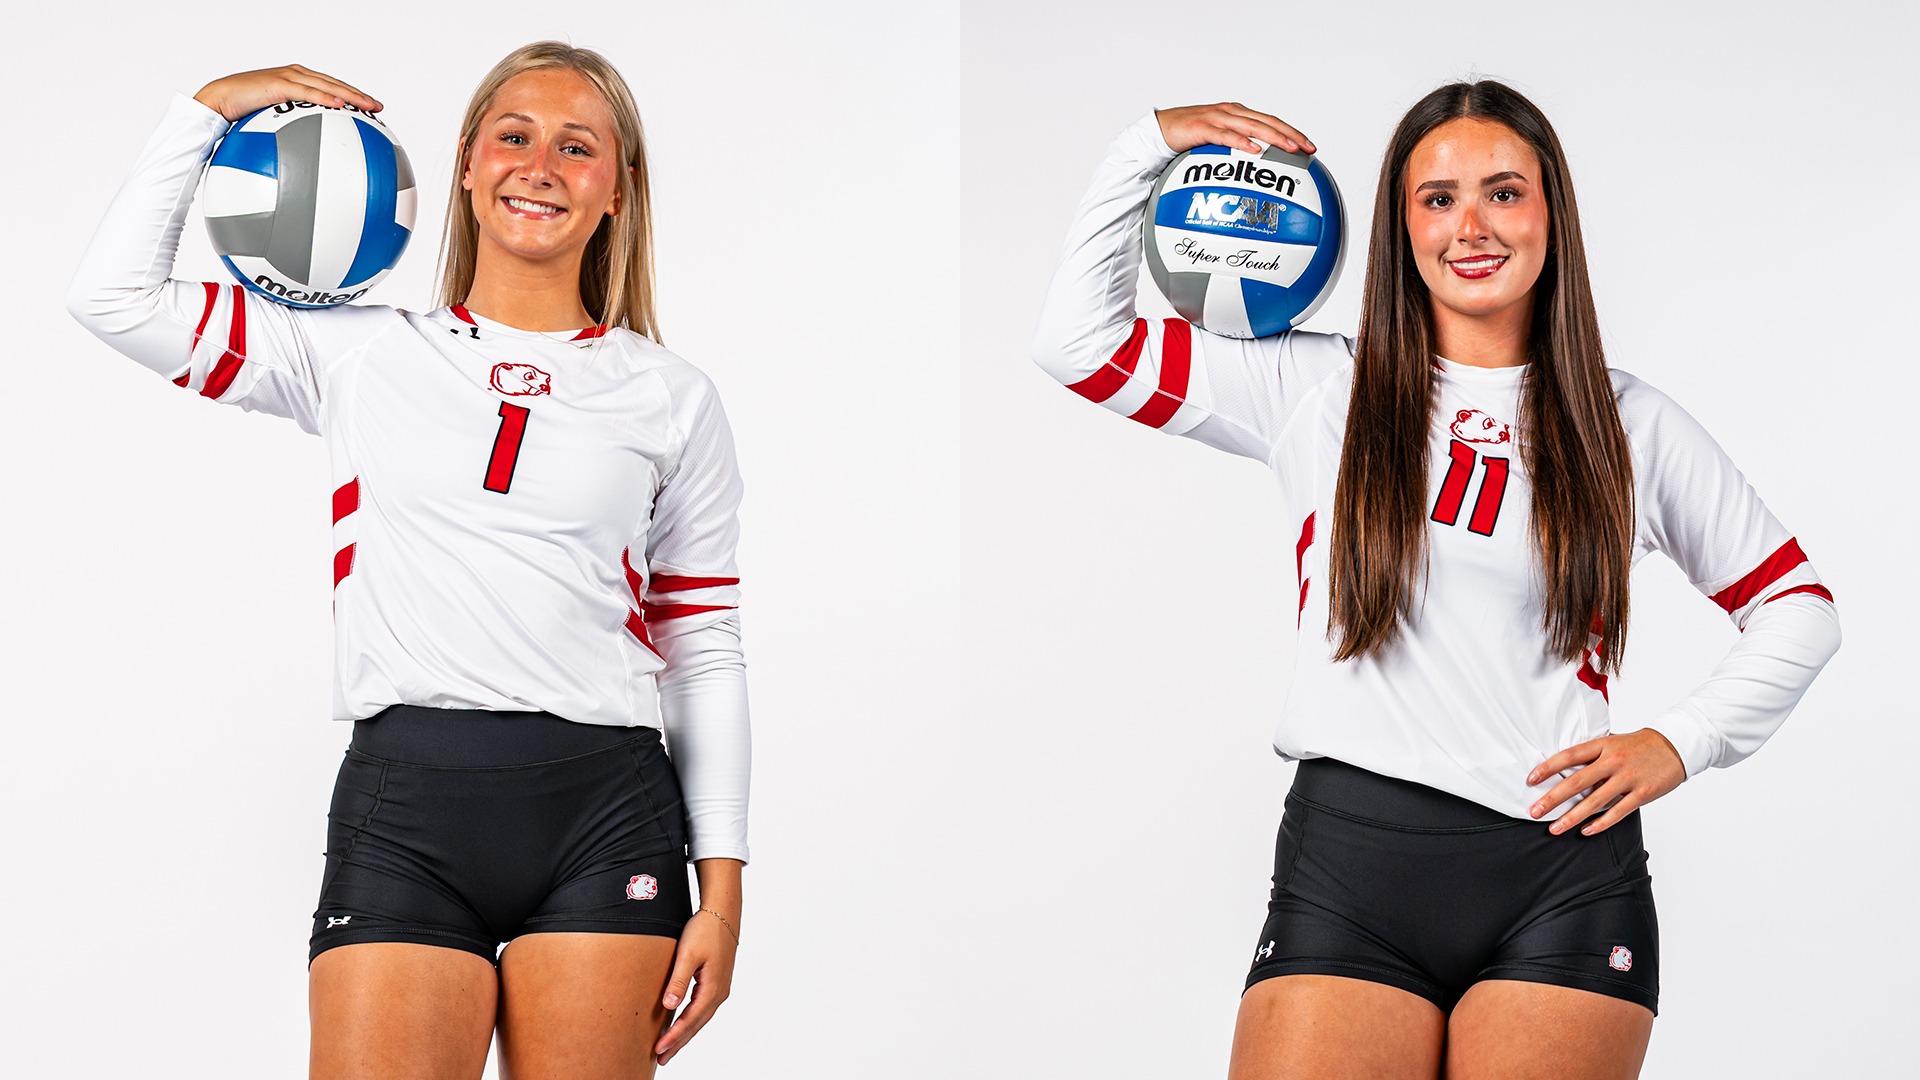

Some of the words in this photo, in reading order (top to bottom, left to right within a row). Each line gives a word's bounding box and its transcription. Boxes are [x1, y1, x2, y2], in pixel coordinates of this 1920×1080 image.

[1183, 160, 1295, 197] molten
[1186, 192, 1279, 230] NCAA
[1174, 237, 1221, 265] Super
[1226, 249, 1281, 271] Touch
[254, 275, 369, 304] molten
[483, 400, 531, 495] 1
[1430, 439, 1509, 537] 11
